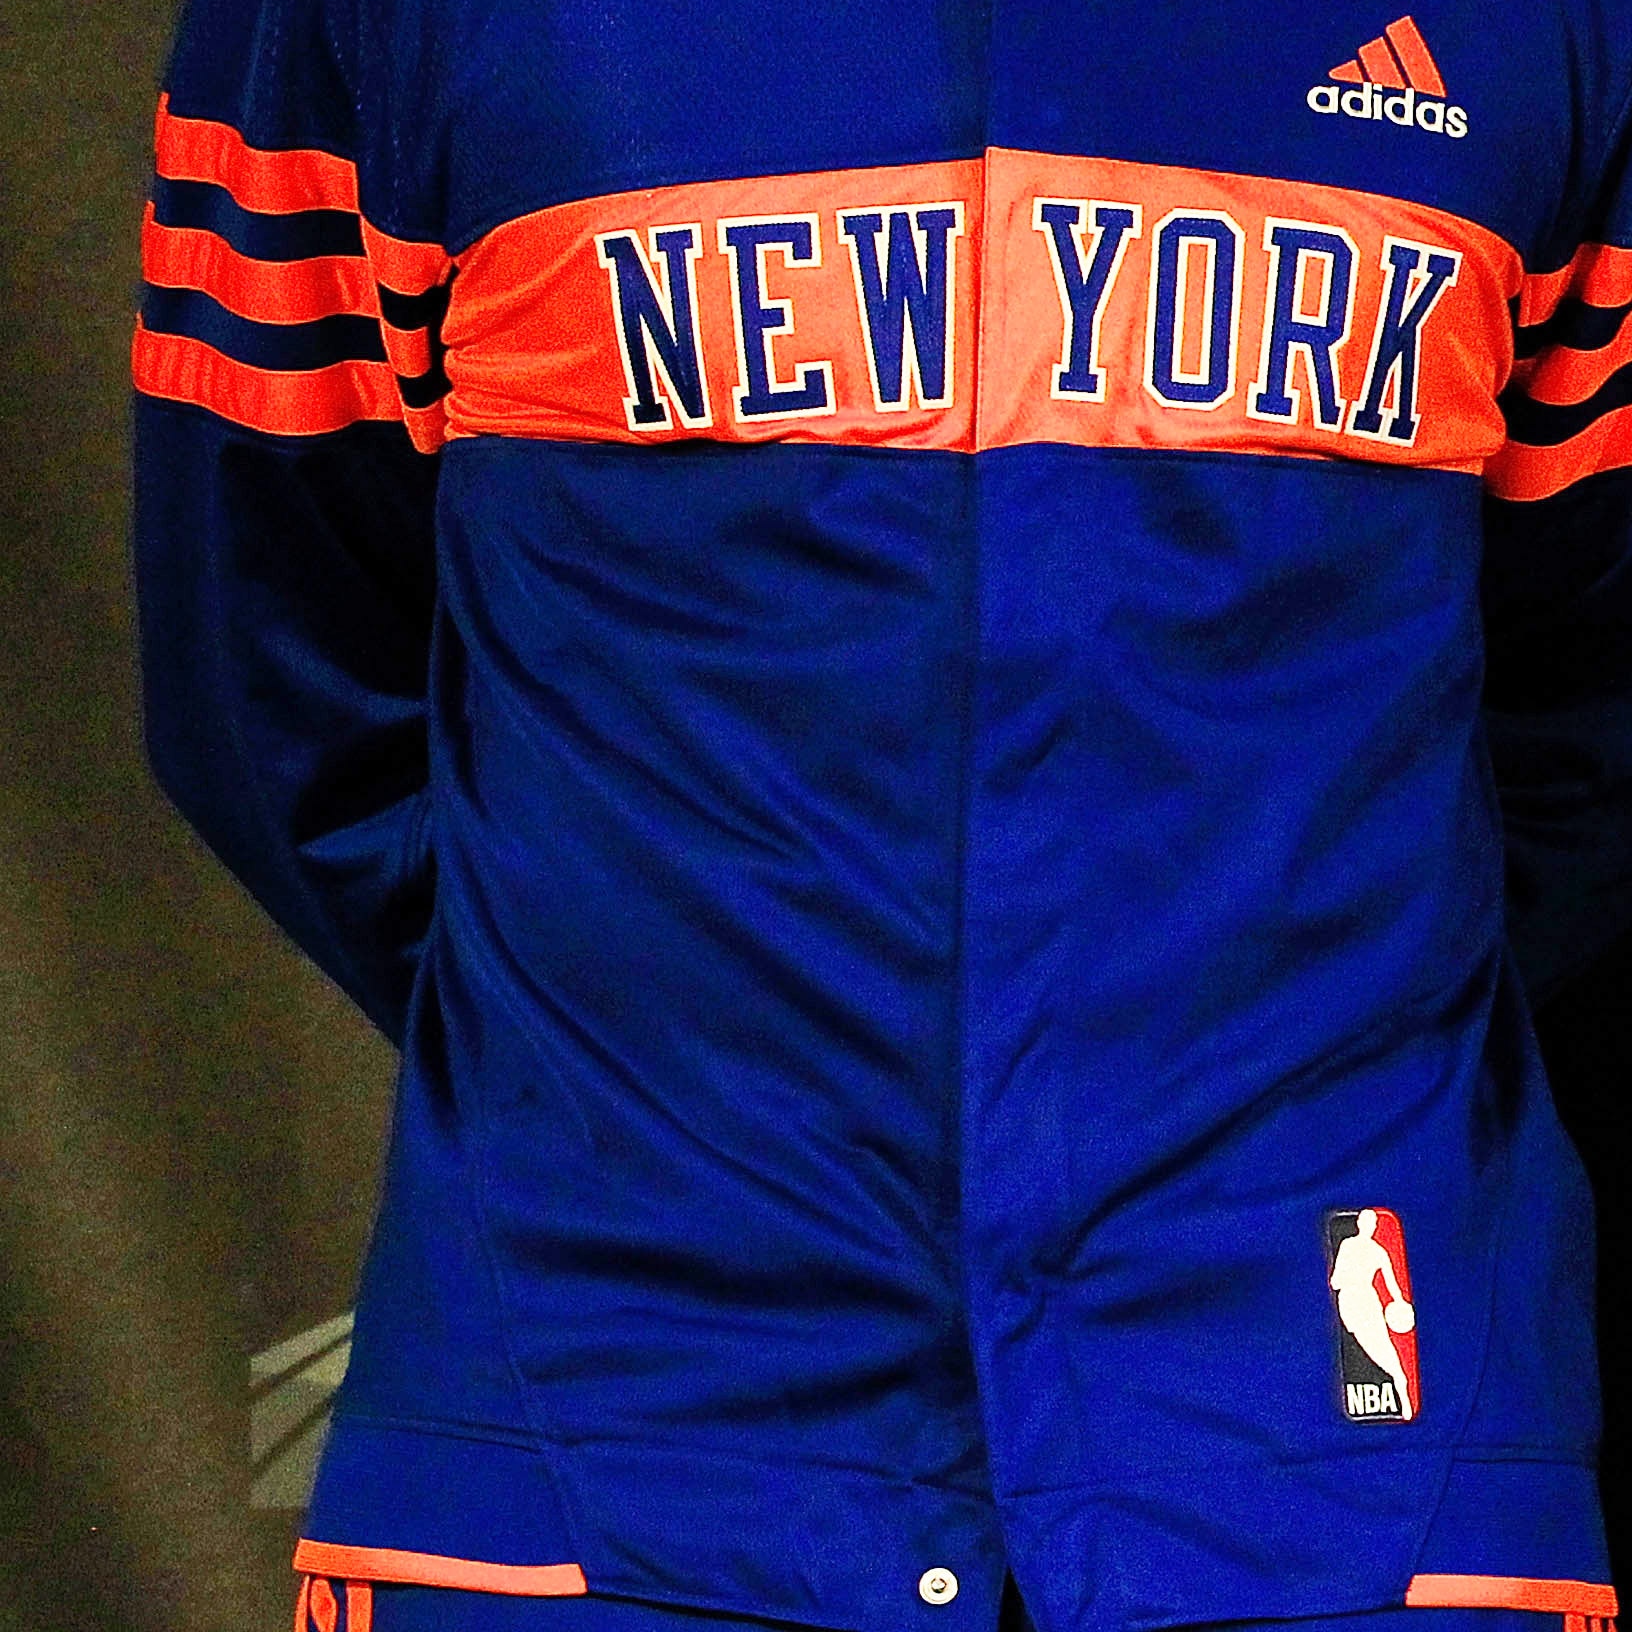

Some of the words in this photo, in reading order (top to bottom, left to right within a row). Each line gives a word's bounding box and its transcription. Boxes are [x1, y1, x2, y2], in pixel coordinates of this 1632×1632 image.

[1306, 81, 1468, 139] adidas
[594, 200, 964, 432] NEW
[1032, 197, 1463, 447] YORK
[1346, 1383, 1398, 1415] NBA
